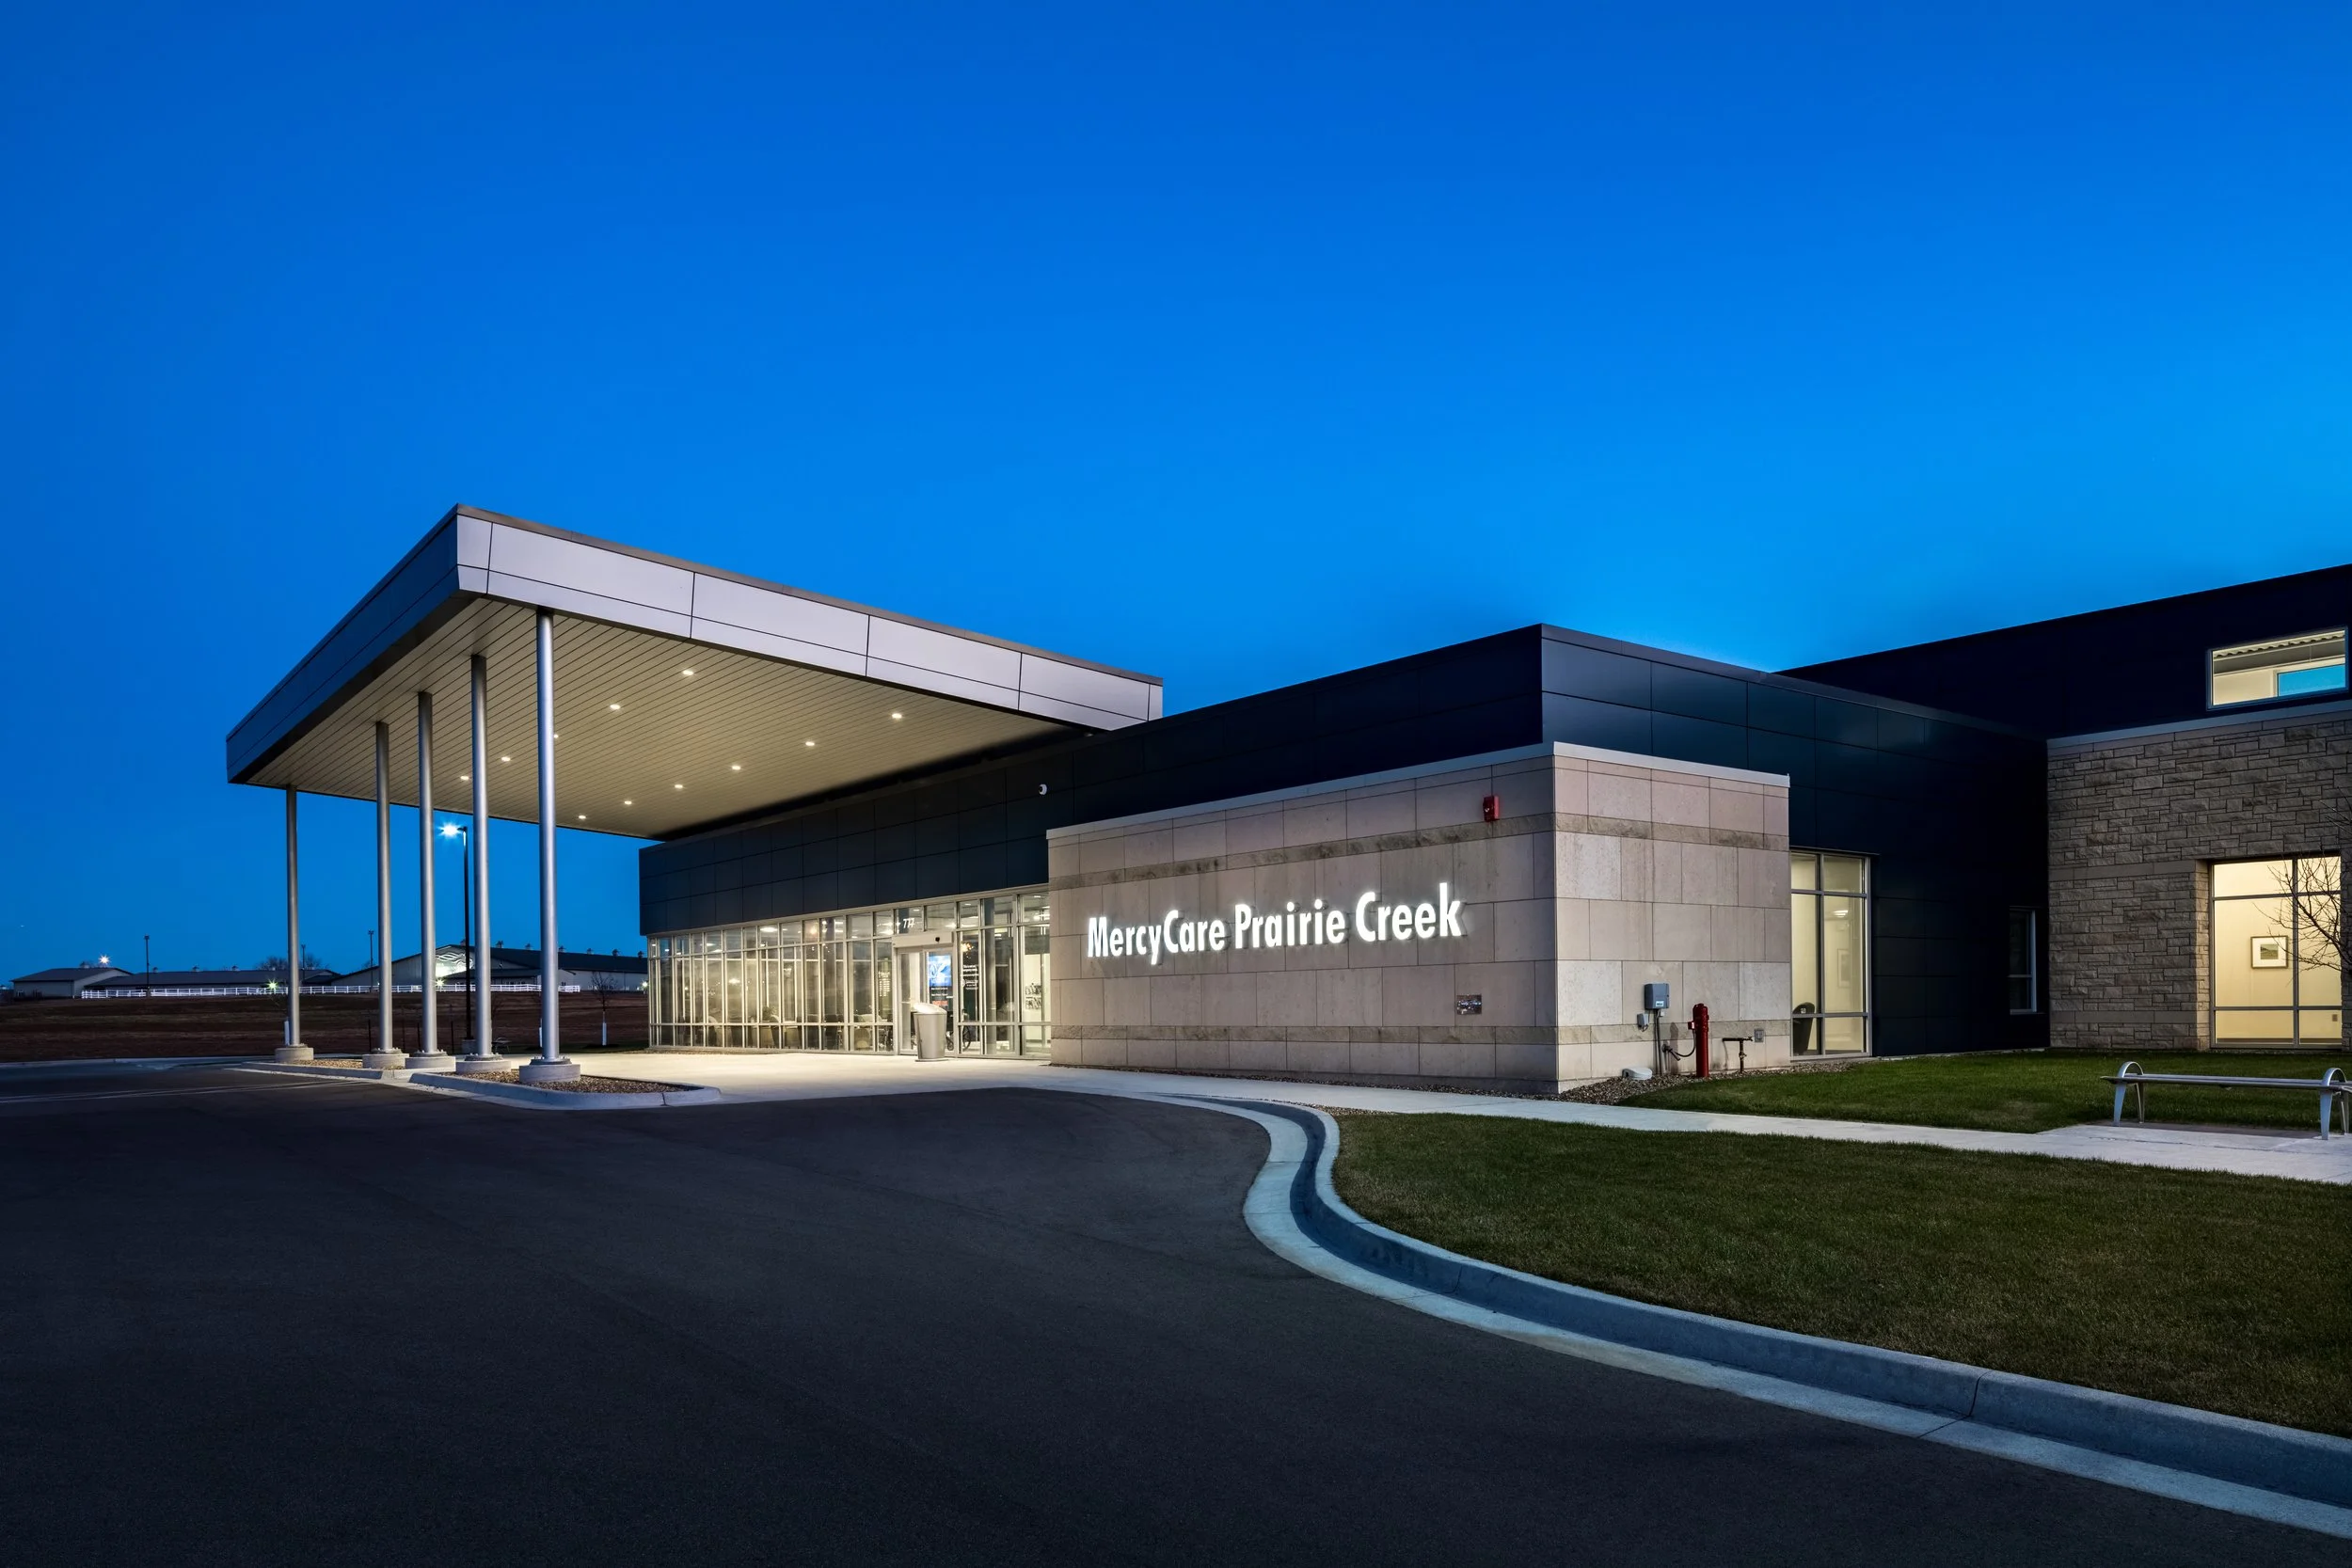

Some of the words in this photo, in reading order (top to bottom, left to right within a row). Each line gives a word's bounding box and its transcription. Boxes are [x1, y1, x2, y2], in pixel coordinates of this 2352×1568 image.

[1088, 910, 1225, 965] MercyCare
[1234, 898, 1345, 949] Prairie
[1355, 882, 1462, 942] Creek
